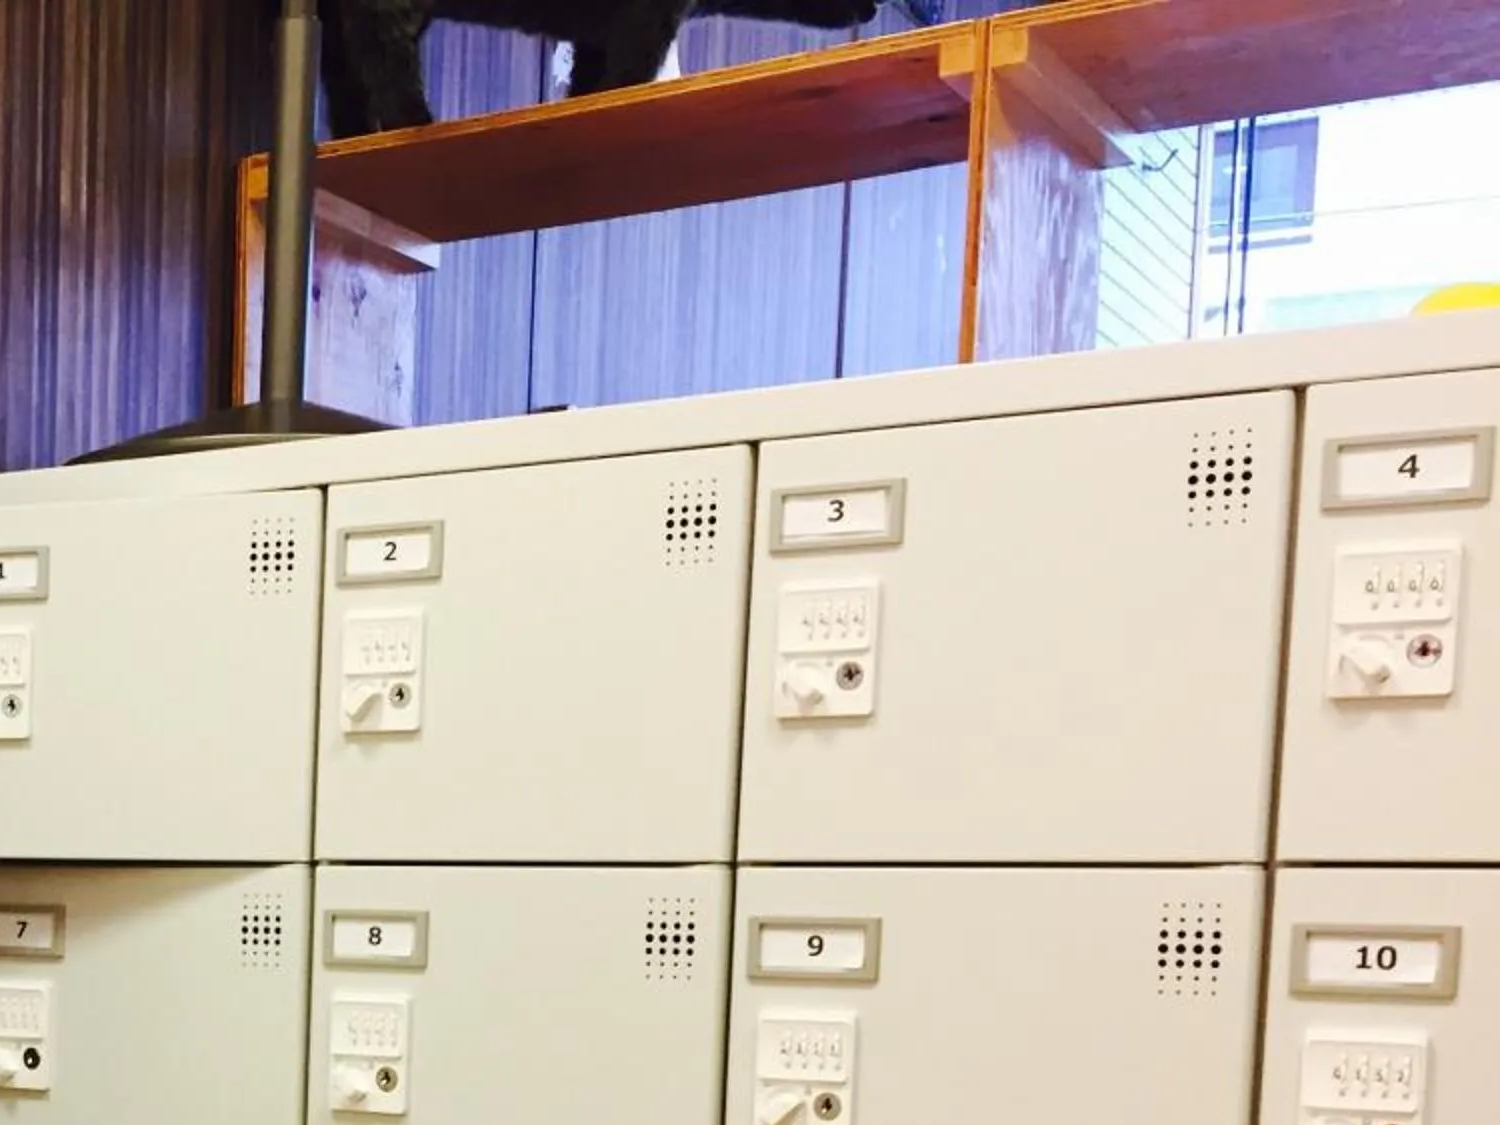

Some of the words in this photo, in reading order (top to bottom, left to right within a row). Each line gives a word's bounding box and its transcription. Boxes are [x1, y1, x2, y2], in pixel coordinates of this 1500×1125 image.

[1398, 454, 1420, 479] 4
[828, 500, 845, 522] 3
[383, 543, 398, 561] 2
[16, 921, 28, 939] 7
[368, 926, 382, 946] 8
[807, 934, 824, 957] 9
[1355, 945, 1398, 971] 10
